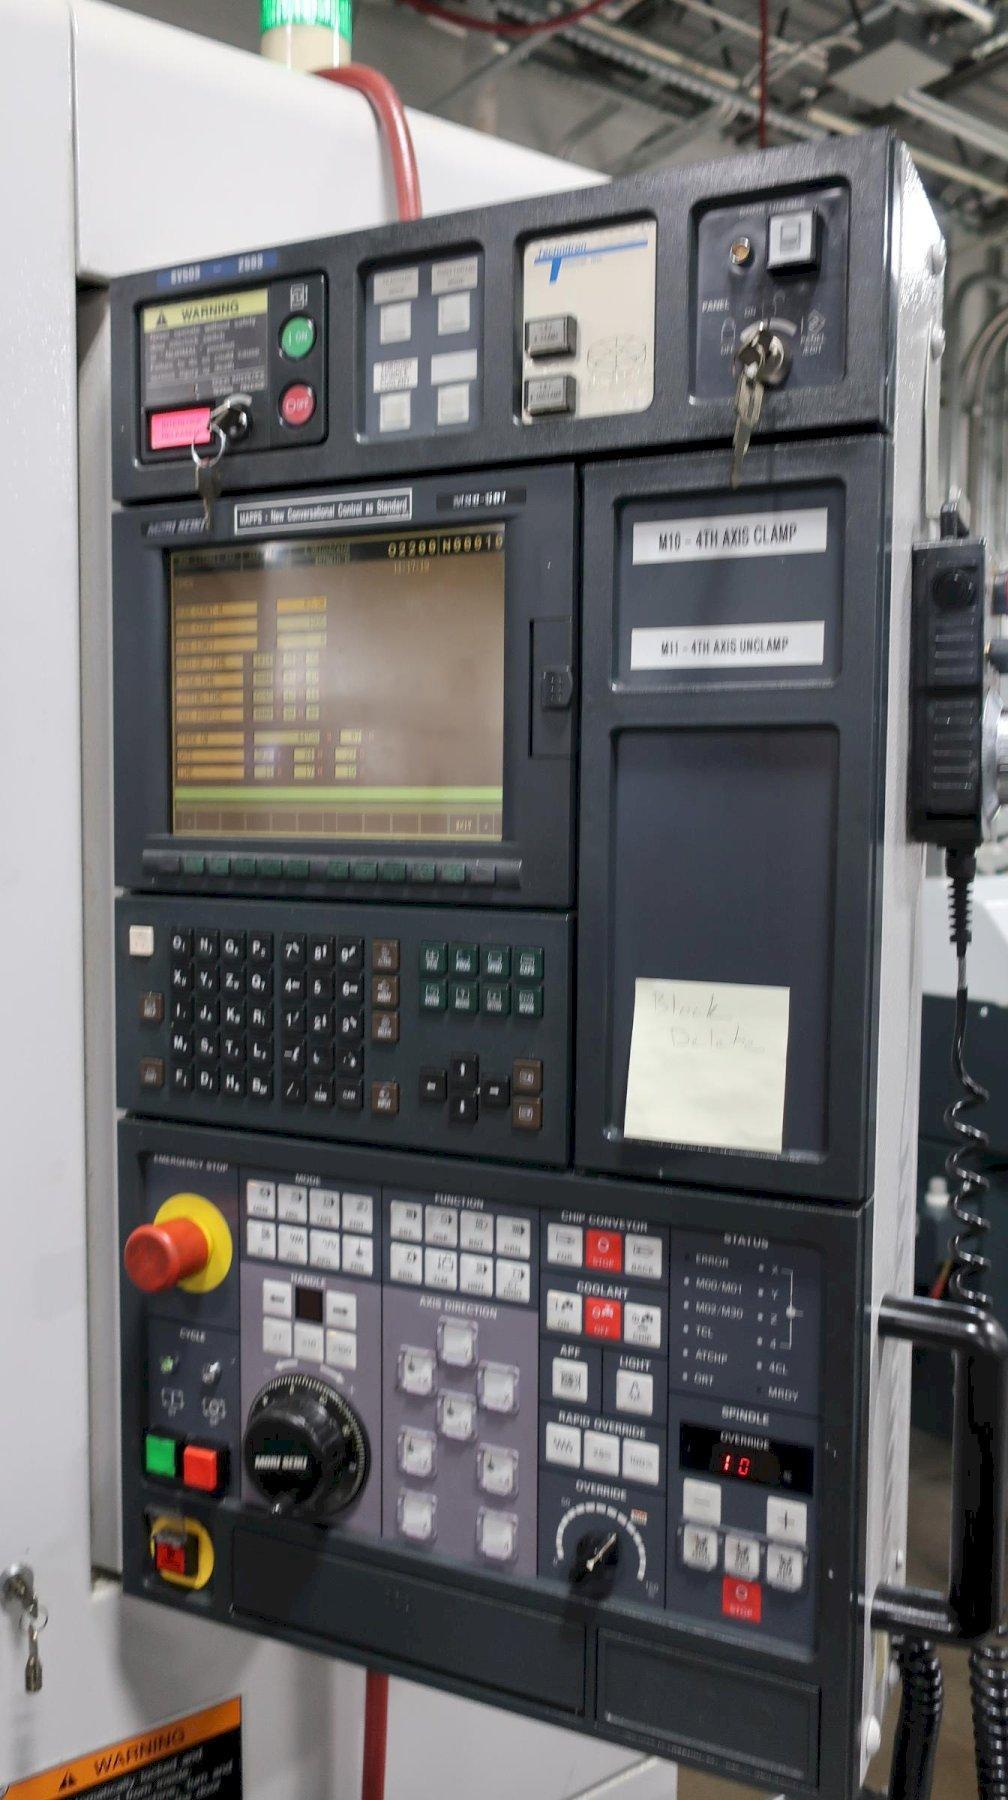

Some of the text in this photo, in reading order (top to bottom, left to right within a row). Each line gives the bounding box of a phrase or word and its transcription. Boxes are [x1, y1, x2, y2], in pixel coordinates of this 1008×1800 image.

[181, 299, 240, 321] WARNING
[239, 509, 262, 526] MAPPS
[270, 509, 284, 525] New
[287, 503, 334, 523] Conversational
[337, 501, 362, 518] Control
[659, 530, 681, 551] M10
[695, 528, 718, 548] 4TH
[722, 525, 749, 546] AXIS
[754, 522, 797, 544] CLAMP
[661, 641, 678, 657] M11
[691, 640, 709, 654] 4TH
[713, 638, 736, 653] AXIS
[739, 636, 788, 653] UNCLAMP
[295, 1172, 320, 1186] MODE
[435, 1193, 484, 1209] FUNCTION
[561, 1209, 648, 1233] CHIP CONVEYOR
[723, 1232, 769, 1249] STATUS
[695, 1252, 729, 1268] ERROR
[290, 1272, 327, 1288] HANDLE
[576, 1280, 629, 1300] COOLANT
[695, 1276, 743, 1295] M00/M01
[420, 1294, 498, 1319] AXIS DIRECTION
[179, 1327, 206, 1342] CYCLE
[619, 1354, 652, 1372] LIGHT
[558, 1409, 646, 1440] RAPID OVERRIDE
[721, 1404, 770, 1427] SPINDLE
[720, 1430, 770, 1451] OVERRIDE
[576, 1478, 627, 1503] OVERRIDE
[94, 1727, 185, 1776] WARNING
